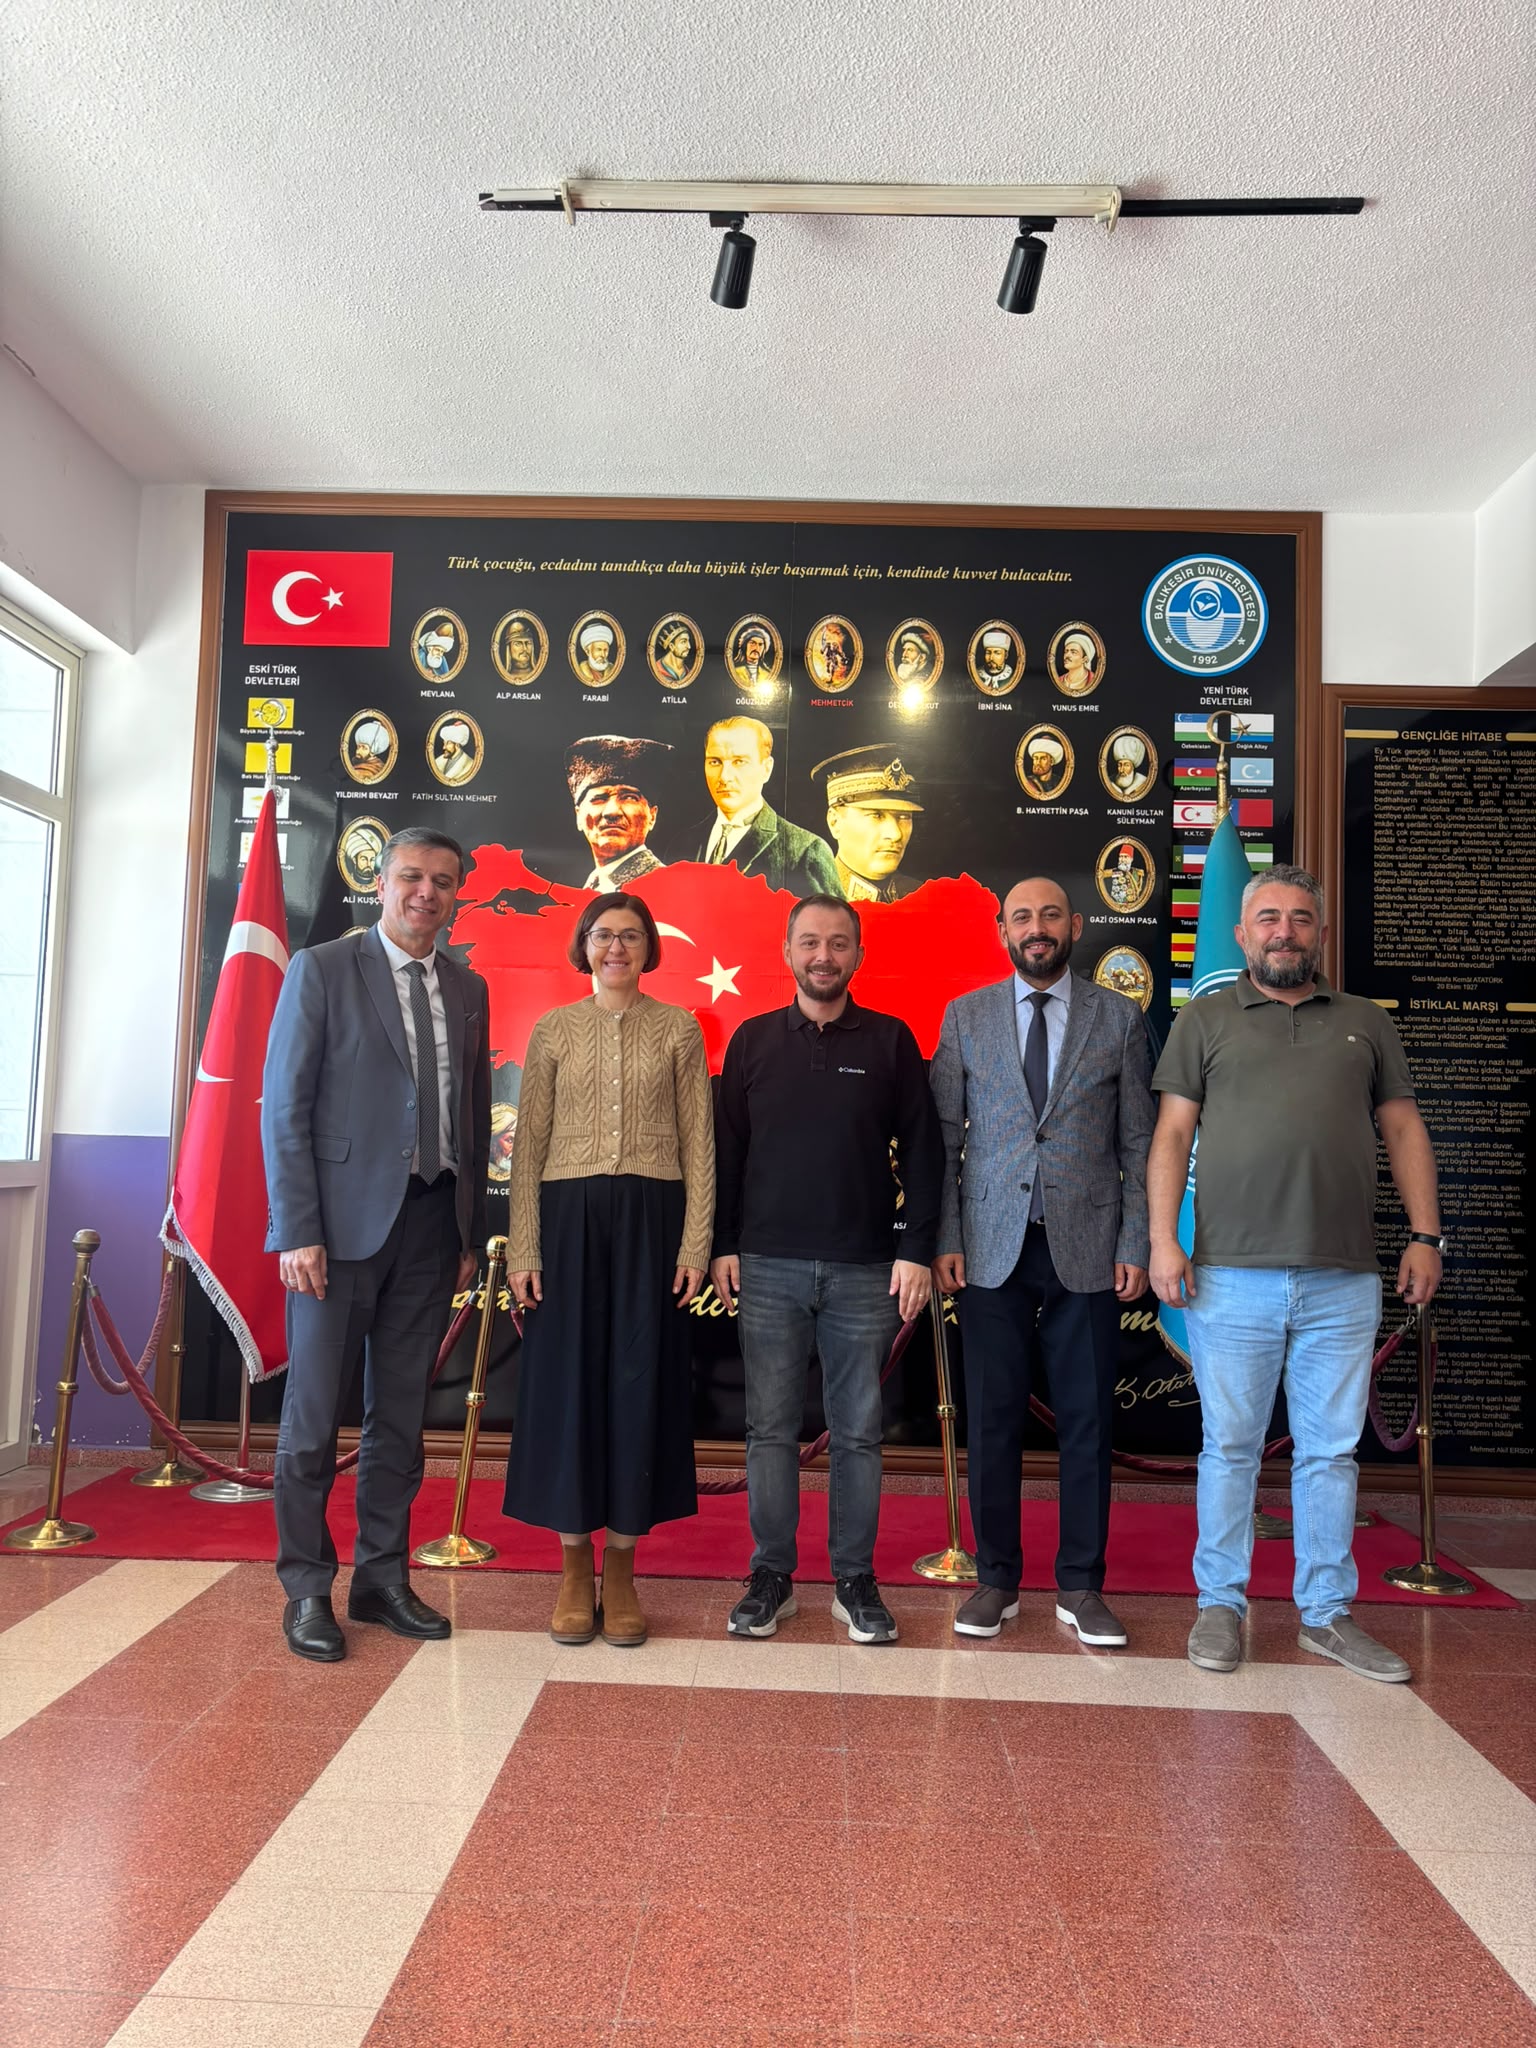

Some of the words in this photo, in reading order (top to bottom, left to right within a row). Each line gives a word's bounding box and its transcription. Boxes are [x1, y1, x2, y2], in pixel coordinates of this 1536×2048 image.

[448, 556, 481, 570] Türk
[484, 558, 536, 574] çocuğu,
[540, 559, 598, 572] ecdadını
[601, 560, 664, 576] tanıdıkça
[667, 561, 702, 574] daha
[705, 561, 747, 577] büyük
[750, 562, 780, 578] işler
[784, 563, 850, 579] başarmak
[853, 564, 882, 580] için,
[887, 566, 950, 580] kendinde
[953, 567, 999, 580] kuvvet
[1000, 568, 1072, 582] bulacaktır.
[1154, 567, 1194, 620] BALIKESİR
[1198, 564, 1258, 622] ÜNİVERSİTESİ
[1192, 655, 1218, 665] 1992
[249, 664, 271, 674] ESKİ
[272, 664, 298, 675] TÜRK
[244, 675, 300, 686] DEVLETLERİ
[420, 690, 456, 699] MEVLANA
[1203, 685, 1224, 695] YENİ
[1226, 686, 1249, 695] TÜRK
[496, 692, 511, 700] ALP
[512, 692, 542, 701] ARSLAN
[582, 693, 610, 703] FARABİ
[661, 695, 688, 705] ATİLLA
[1200, 696, 1252, 706] DEVLETLERİ
[810, 698, 854, 708] MEHMETÇİK
[978, 701, 994, 711] İBNİ
[995, 702, 1013, 712] SİNA
[1052, 704, 1078, 713] YUNUS
[1079, 704, 1100, 713] EMRE
[1401, 730, 1459, 742] GENÇLİĞE
[1462, 730, 1502, 742] HİTABE
[1181, 742, 1211, 750] Özbekistan
[1180, 785, 1212, 793] Azerbaycan
[336, 791, 368, 800] YILDIRIM
[369, 791, 399, 800] BEYAZIT
[412, 792, 433, 801] FATİH
[435, 793, 464, 802] SULTAN
[465, 794, 498, 803] MEHMET
[1016, 807, 1025, 815] B.
[1026, 806, 1068, 816] HAYRETTİN
[1069, 808, 1089, 817] PAŞA
[1107, 808, 1135, 817] KANUNİ
[1136, 809, 1164, 818] SULTAN
[1117, 817, 1156, 825] SÜLEYMAN
[342, 895, 356, 904] ALİ
[357, 896, 381, 906] KUŞÇ
[1089, 915, 1107, 924] GAZİ
[1108, 916, 1136, 925] OSMAN
[1137, 917, 1158, 926] PAŞA
[1473, 976, 1504, 984] ATATÜRK
[1410, 998, 1460, 1010] İSTİKLAL
[1463, 1001, 1499, 1013] MARŞI
